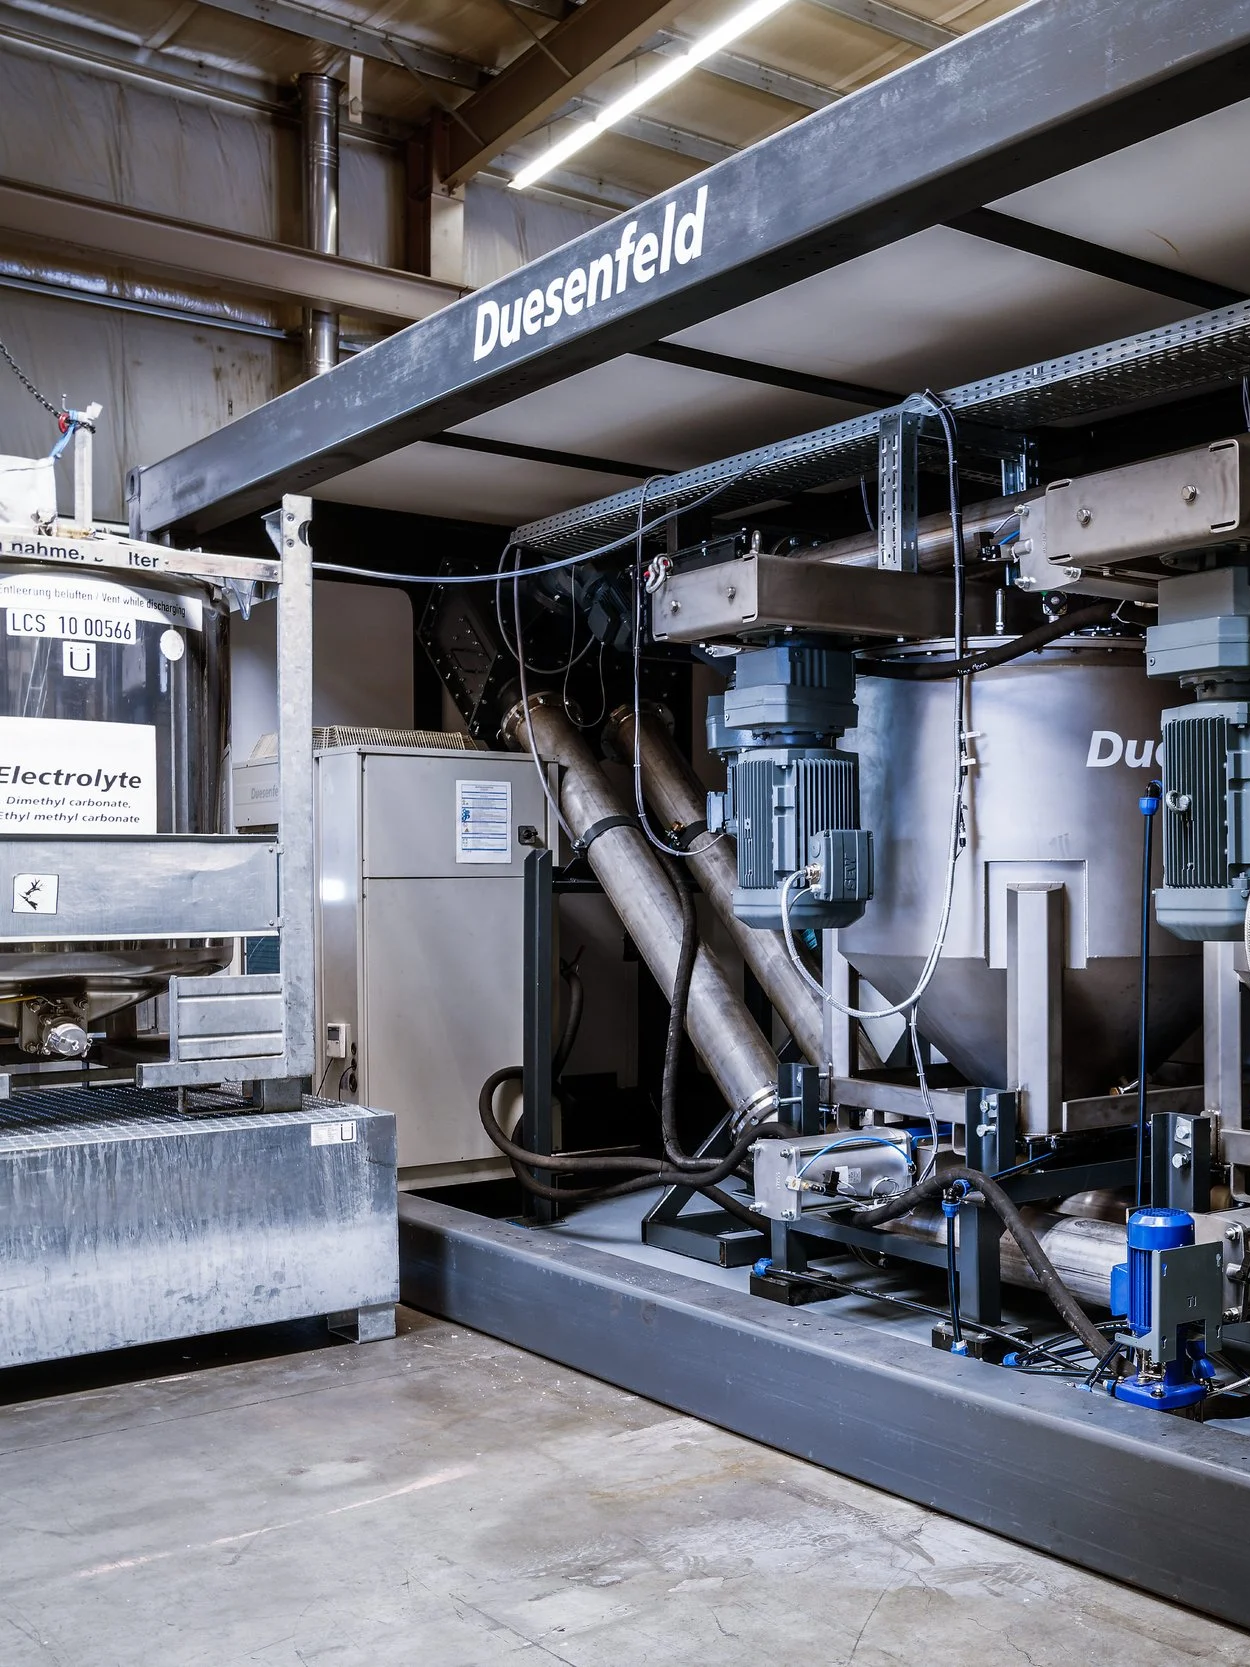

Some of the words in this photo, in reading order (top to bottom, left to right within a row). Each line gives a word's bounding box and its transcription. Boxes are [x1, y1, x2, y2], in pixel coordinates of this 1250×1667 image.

[473, 184, 708, 362] Duesenfeld
[102, 592, 120, 604] Vent
[123, 596, 144, 608] while
[147, 599, 186, 618] discharging
[12, 613, 46, 632] LCS
[58, 616, 78, 635] 10
[84, 618, 132, 640] 00566
[69, 646, 91, 672] Ü
[0, 765, 142, 792] Electrolyte
[6, 796, 66, 808] Dimethyl
[34, 813, 79, 823] methyl
[82, 814, 140, 823] carbonate
[844, 852, 857, 891] SEW
